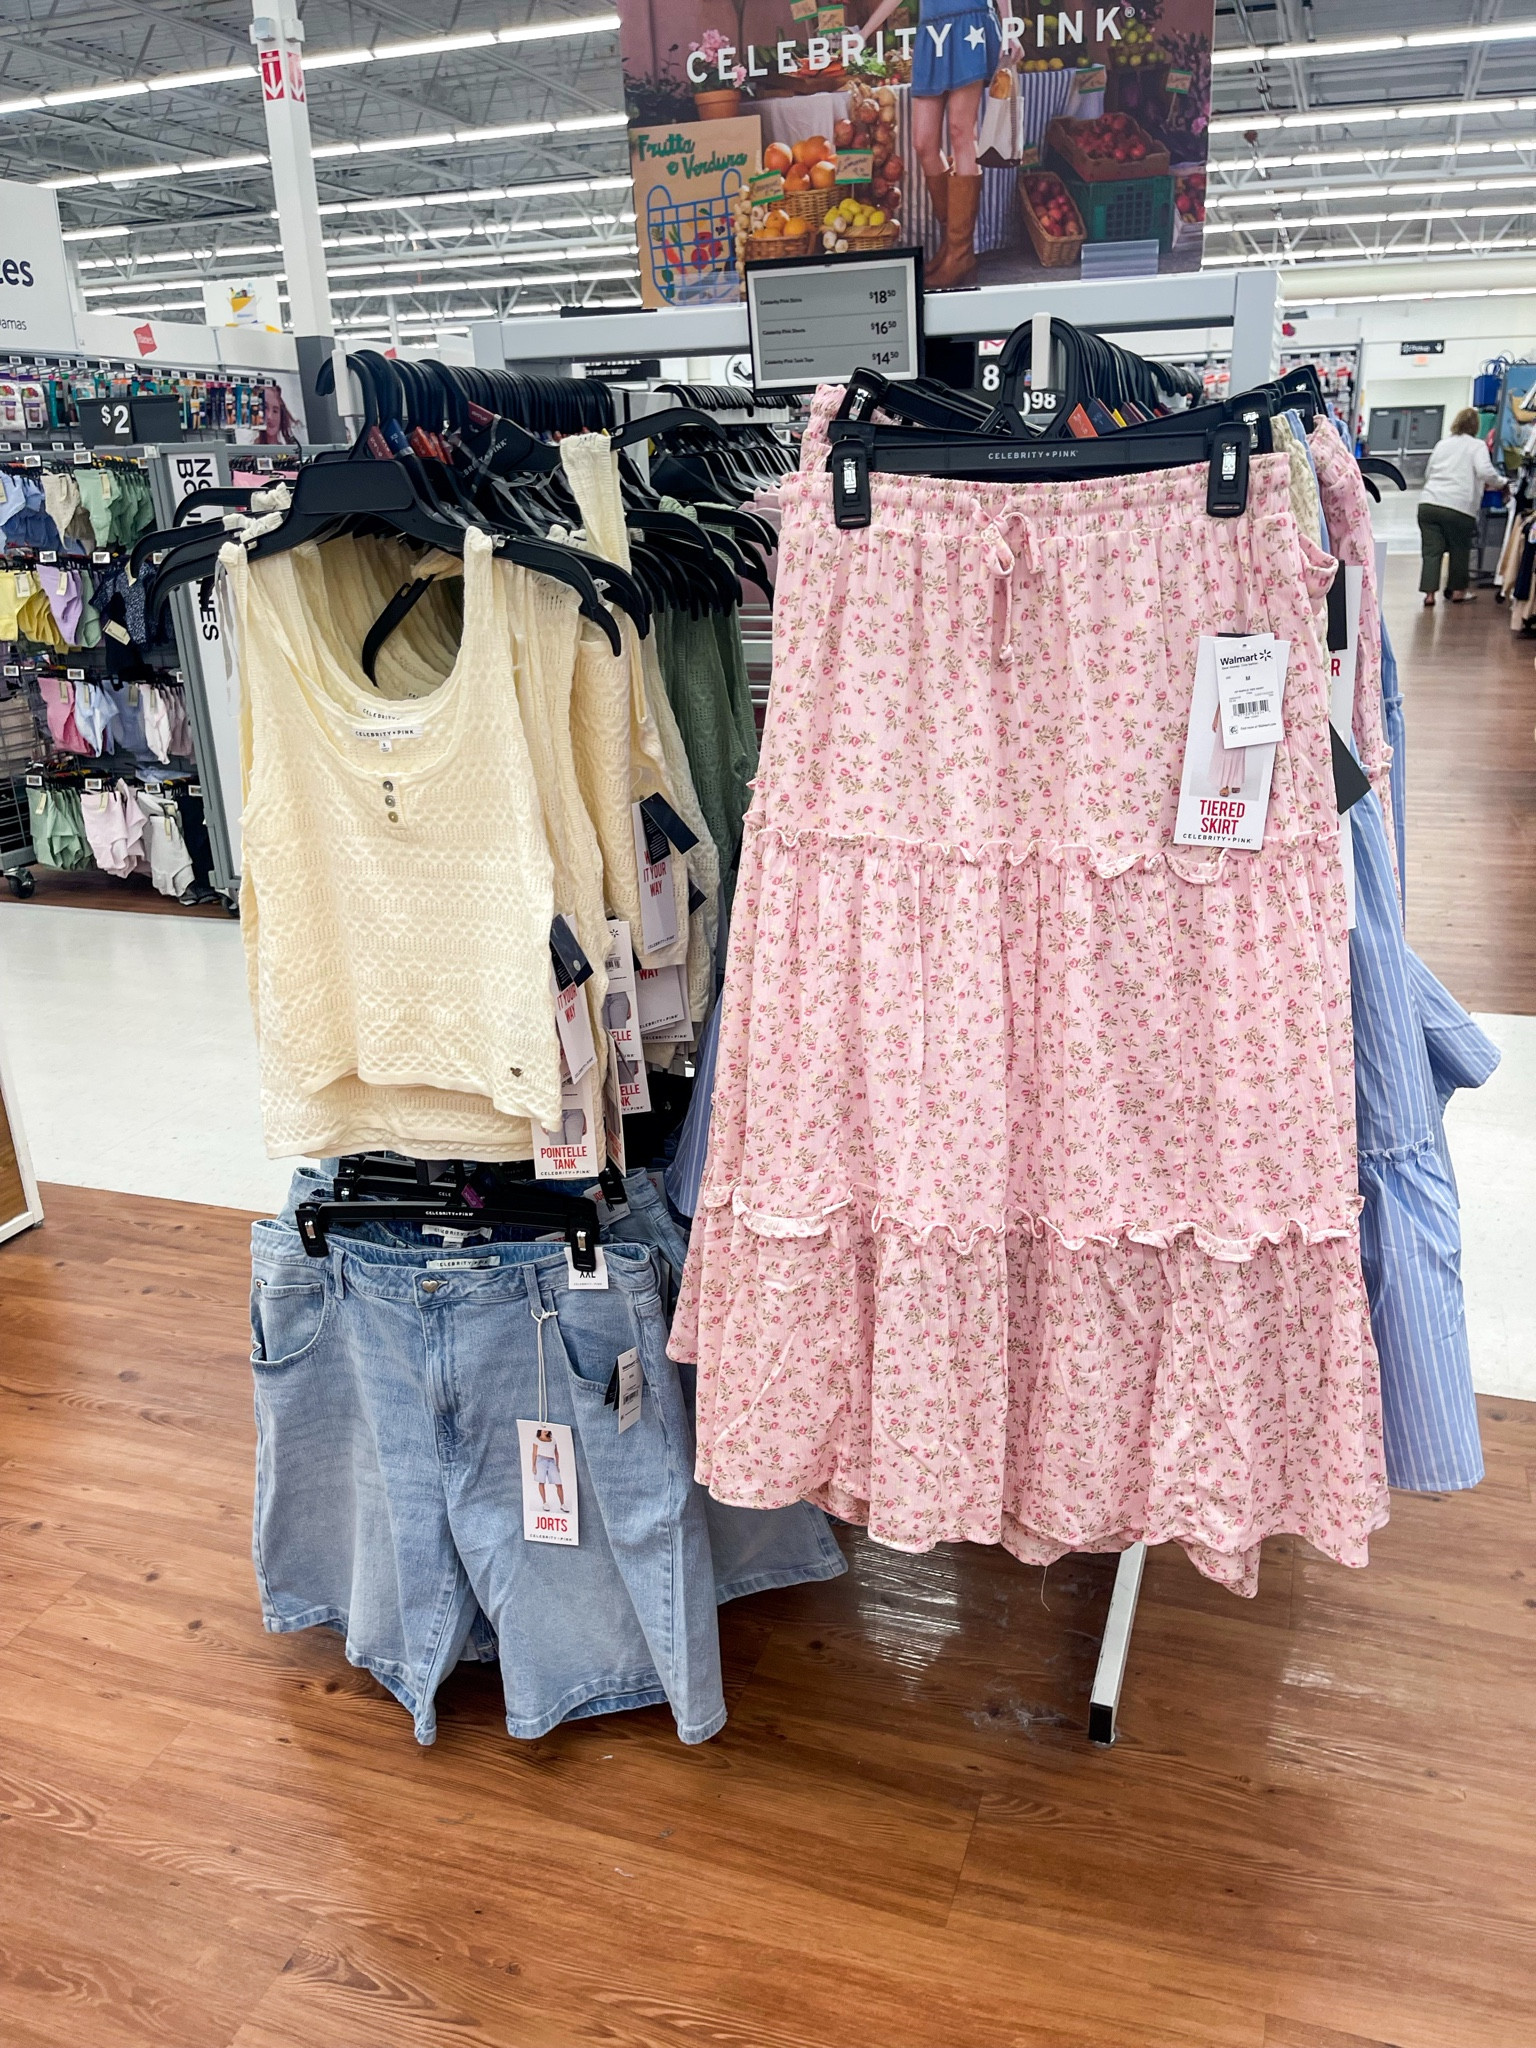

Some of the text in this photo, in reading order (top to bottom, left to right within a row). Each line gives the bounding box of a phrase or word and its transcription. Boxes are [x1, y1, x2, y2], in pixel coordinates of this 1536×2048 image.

[686, 25, 952, 84] CELEBRITY
[638, 133, 695, 161] Frutta
[988, 451, 1044, 461] CELEBRITY
[1219, 652, 1258, 666] Walmart
[1200, 799, 1246, 818] TIERED
[1200, 817, 1239, 836] SKIRT
[1182, 833, 1227, 842] CELEBRITY
[649, 880, 663, 897] WAY
[540, 1145, 588, 1159] POINTELLE
[552, 1158, 577, 1170] TANK
[535, 1516, 568, 1532] JORTS
